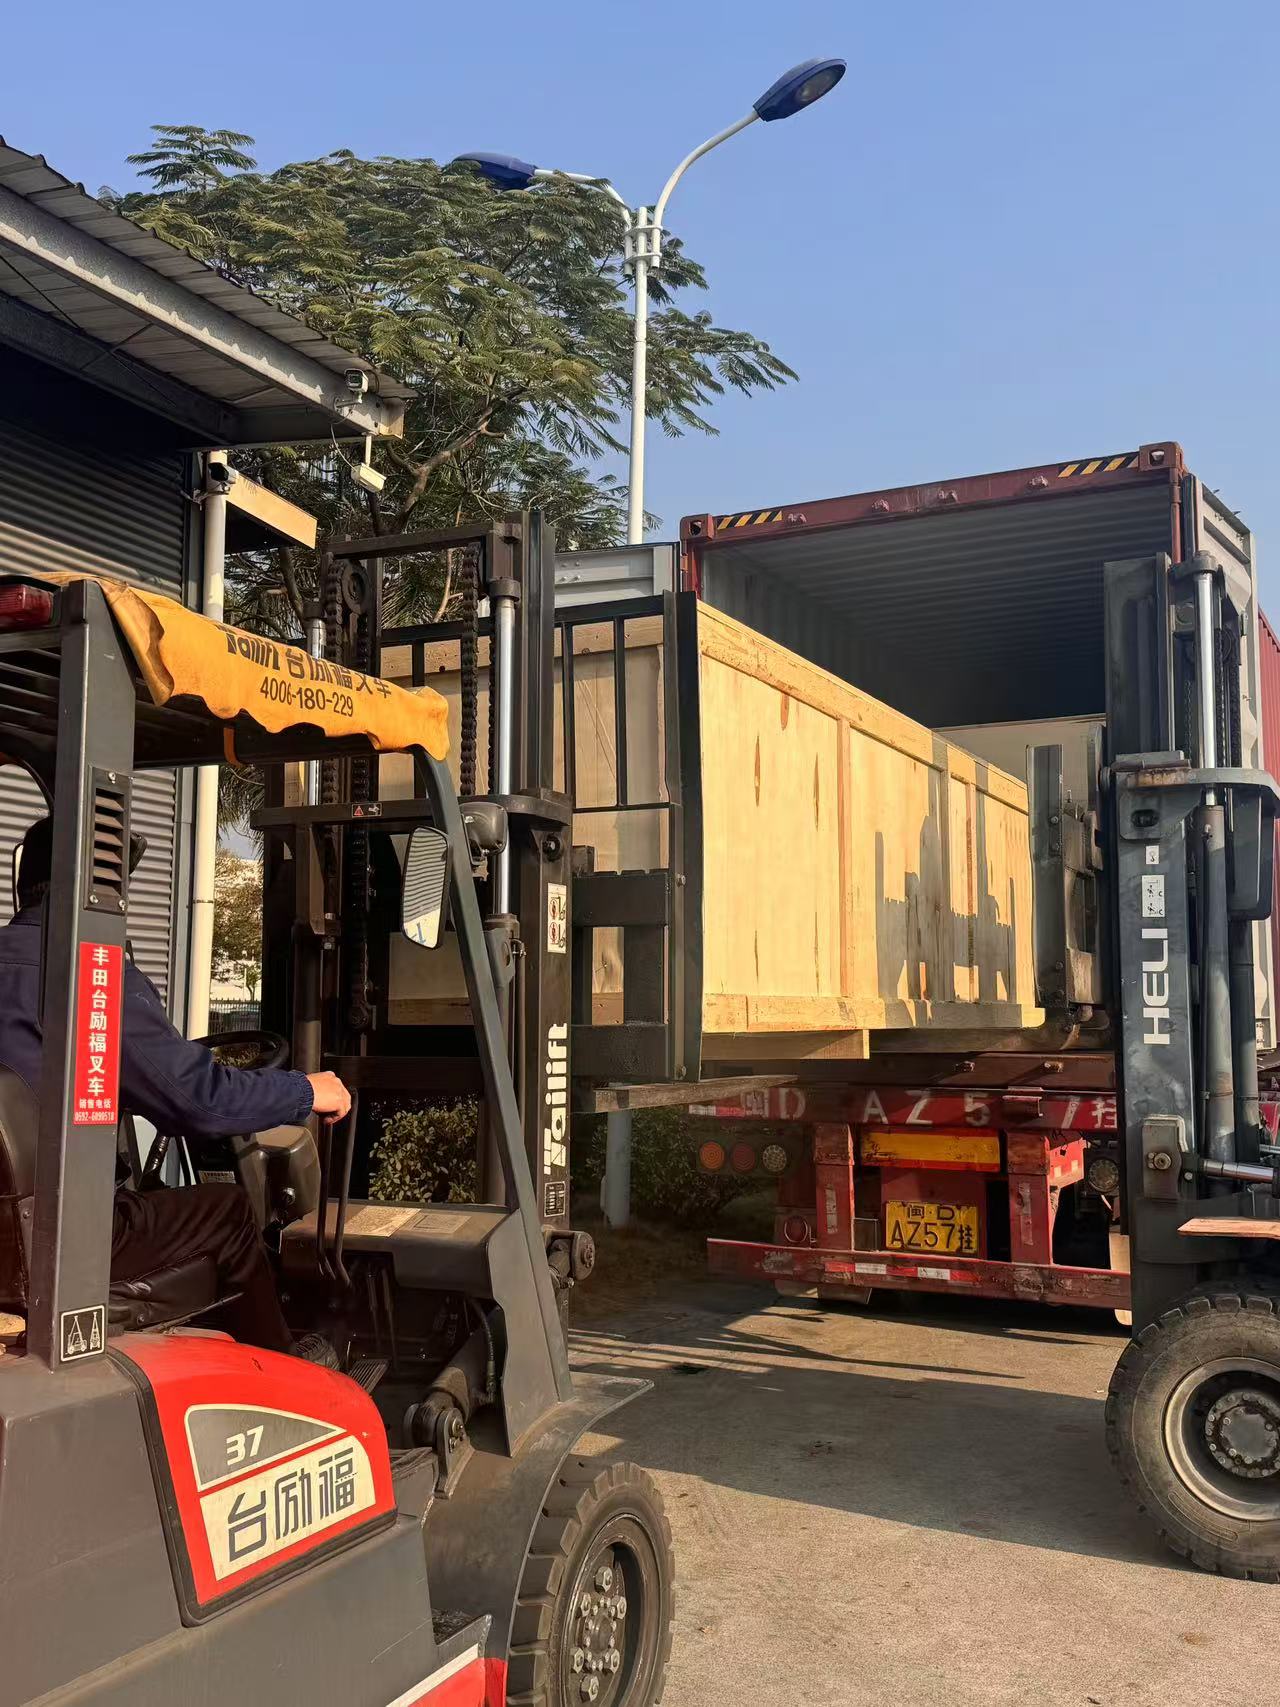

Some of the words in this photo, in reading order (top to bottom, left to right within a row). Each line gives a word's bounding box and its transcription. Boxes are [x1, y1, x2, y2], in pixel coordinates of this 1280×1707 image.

[260, 677, 354, 717] 4006-180-229
[87, 946, 110, 1096] 丰田台励福叉车
[1141, 928, 1171, 1045] HELI
[543, 1022, 568, 1175] Tailift
[891, 1220, 973, 1250] AZ57挂
[226, 1425, 264, 1466] 37
[227, 1446, 355, 1562] 台励福
